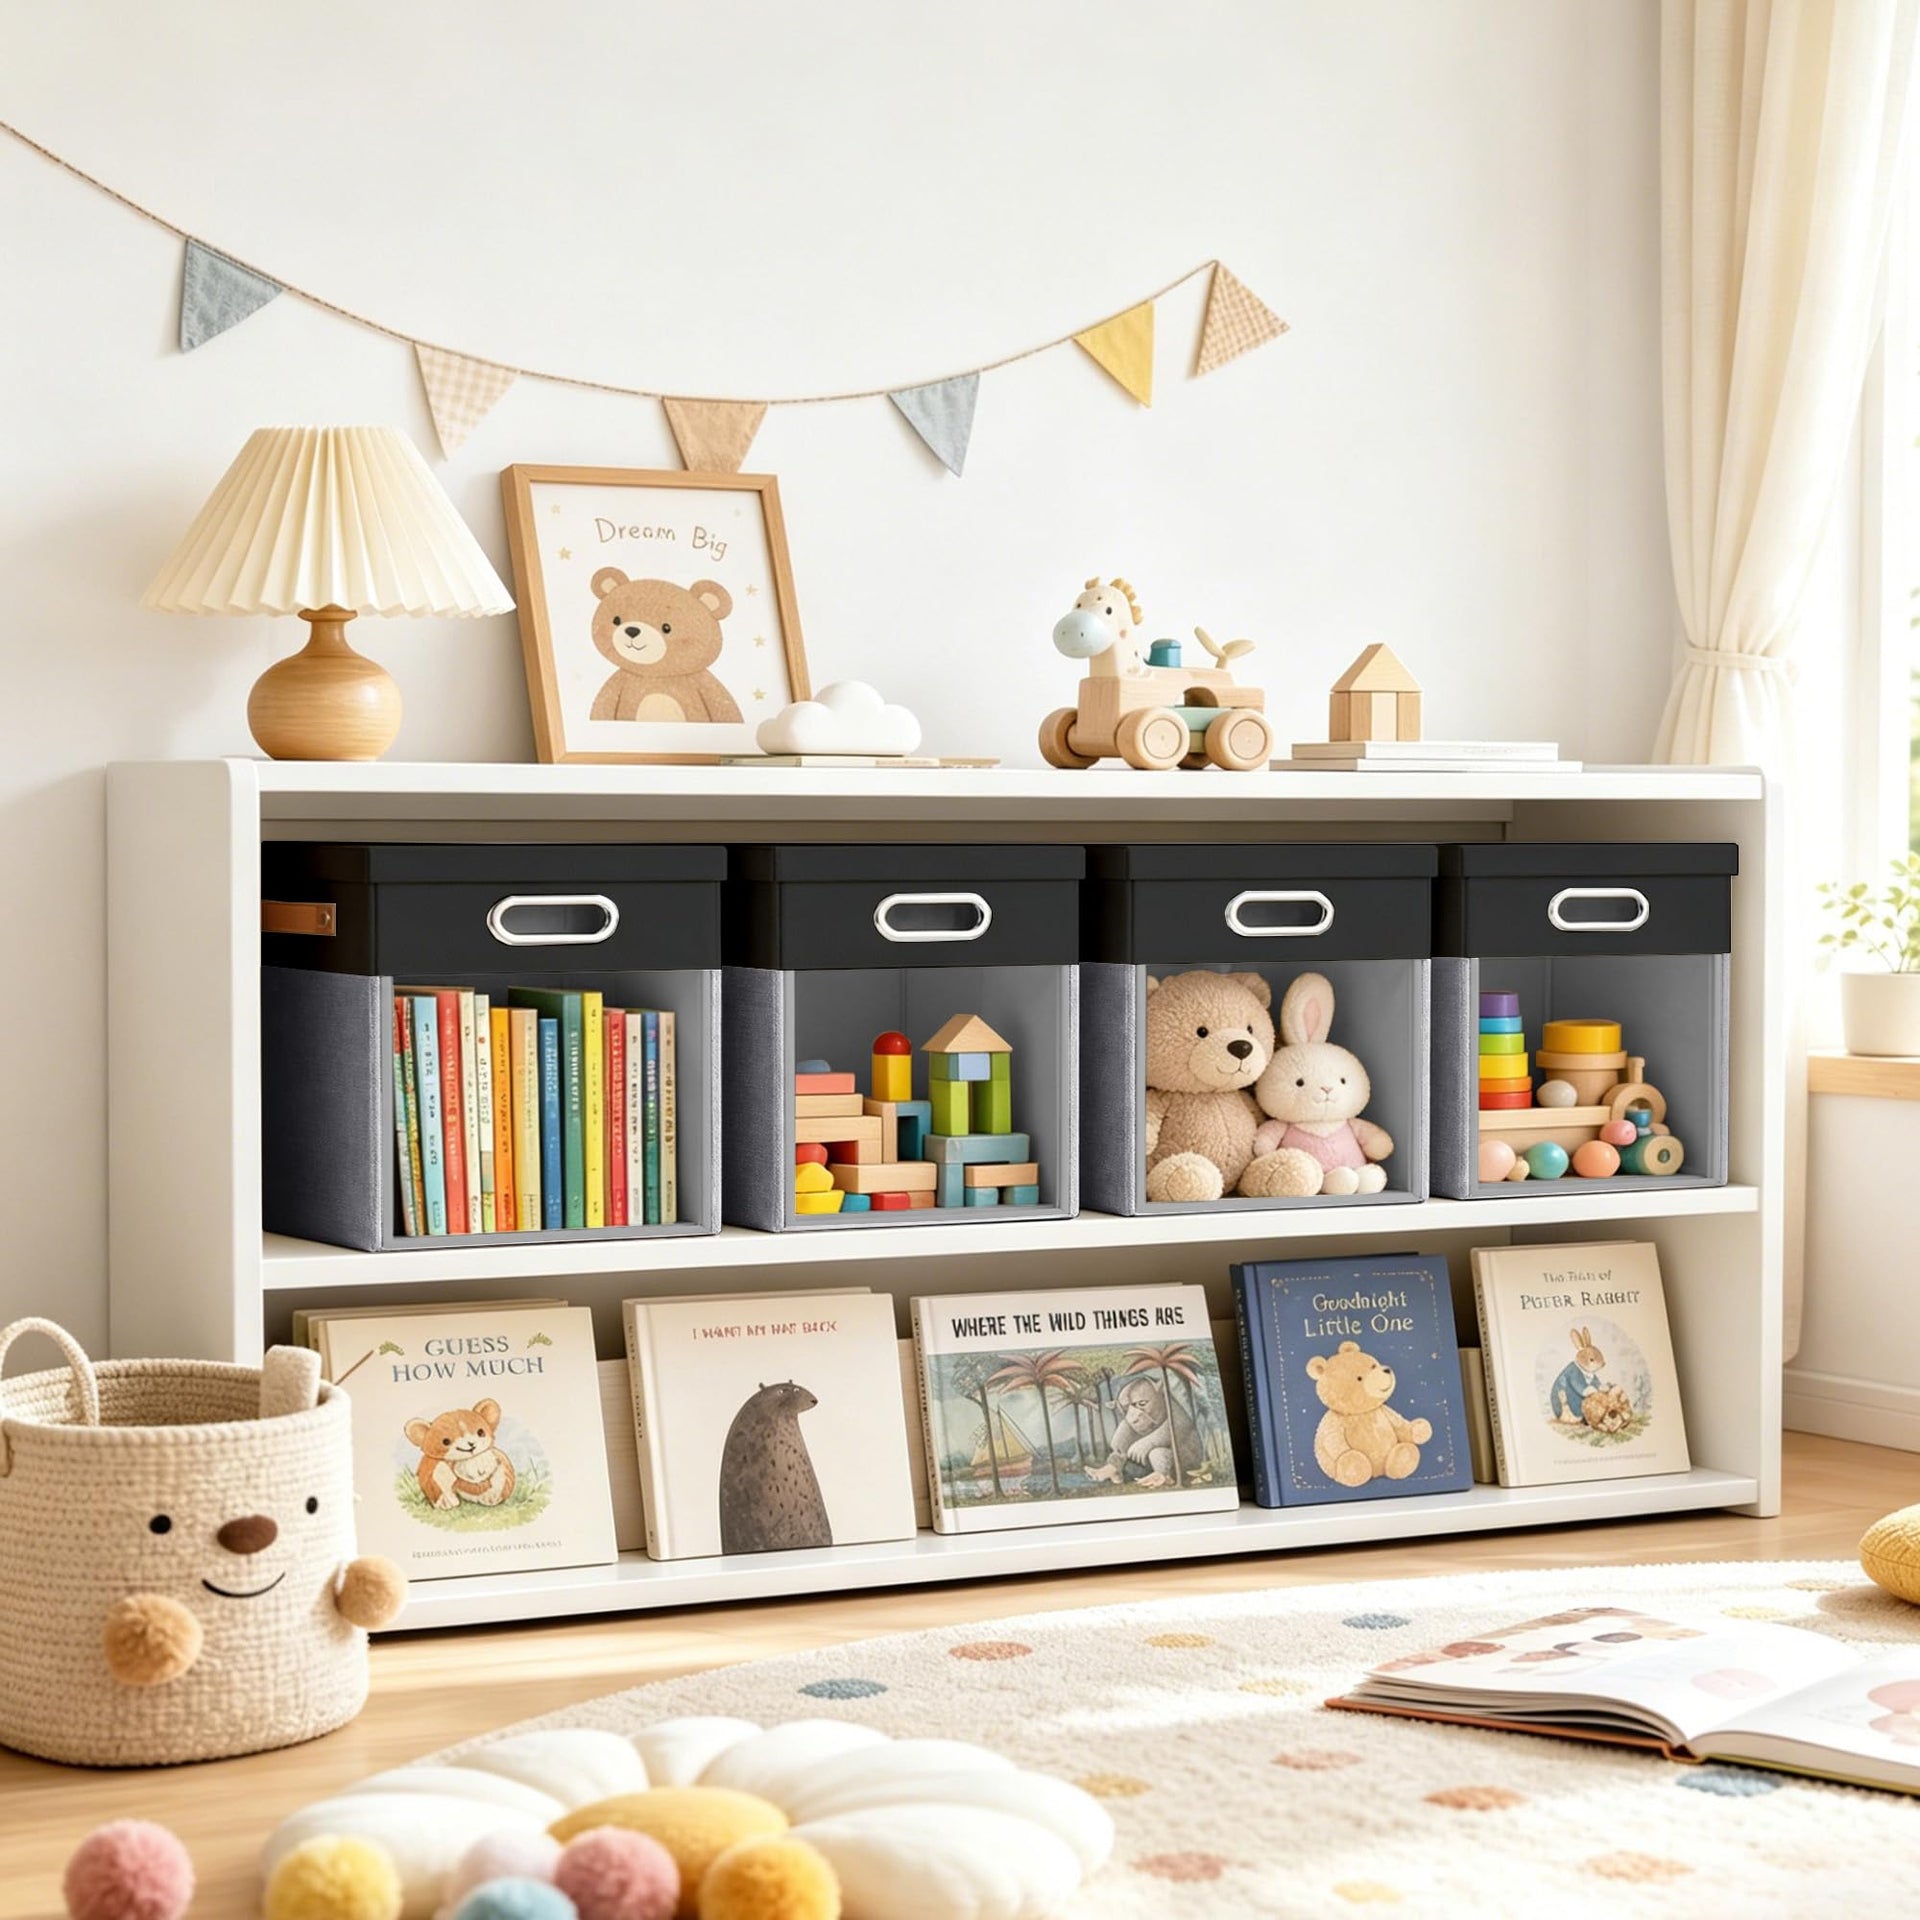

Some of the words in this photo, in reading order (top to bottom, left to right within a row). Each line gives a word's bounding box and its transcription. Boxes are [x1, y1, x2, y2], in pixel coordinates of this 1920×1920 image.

[595, 517, 676, 543] Dream
[692, 525, 728, 562] Big
[1312, 1290, 1408, 1313] Goodnight
[951, 1315, 1007, 1338] WHERE
[1013, 1313, 1042, 1334] THE
[1049, 1312, 1086, 1332] WILD
[1092, 1308, 1150, 1330] THINGS
[1303, 1315, 1363, 1338] Little
[1371, 1313, 1414, 1333] One
[424, 1335, 510, 1357] GUESS
[392, 1362, 456, 1383] HOW
[466, 1356, 544, 1378] MUCH
